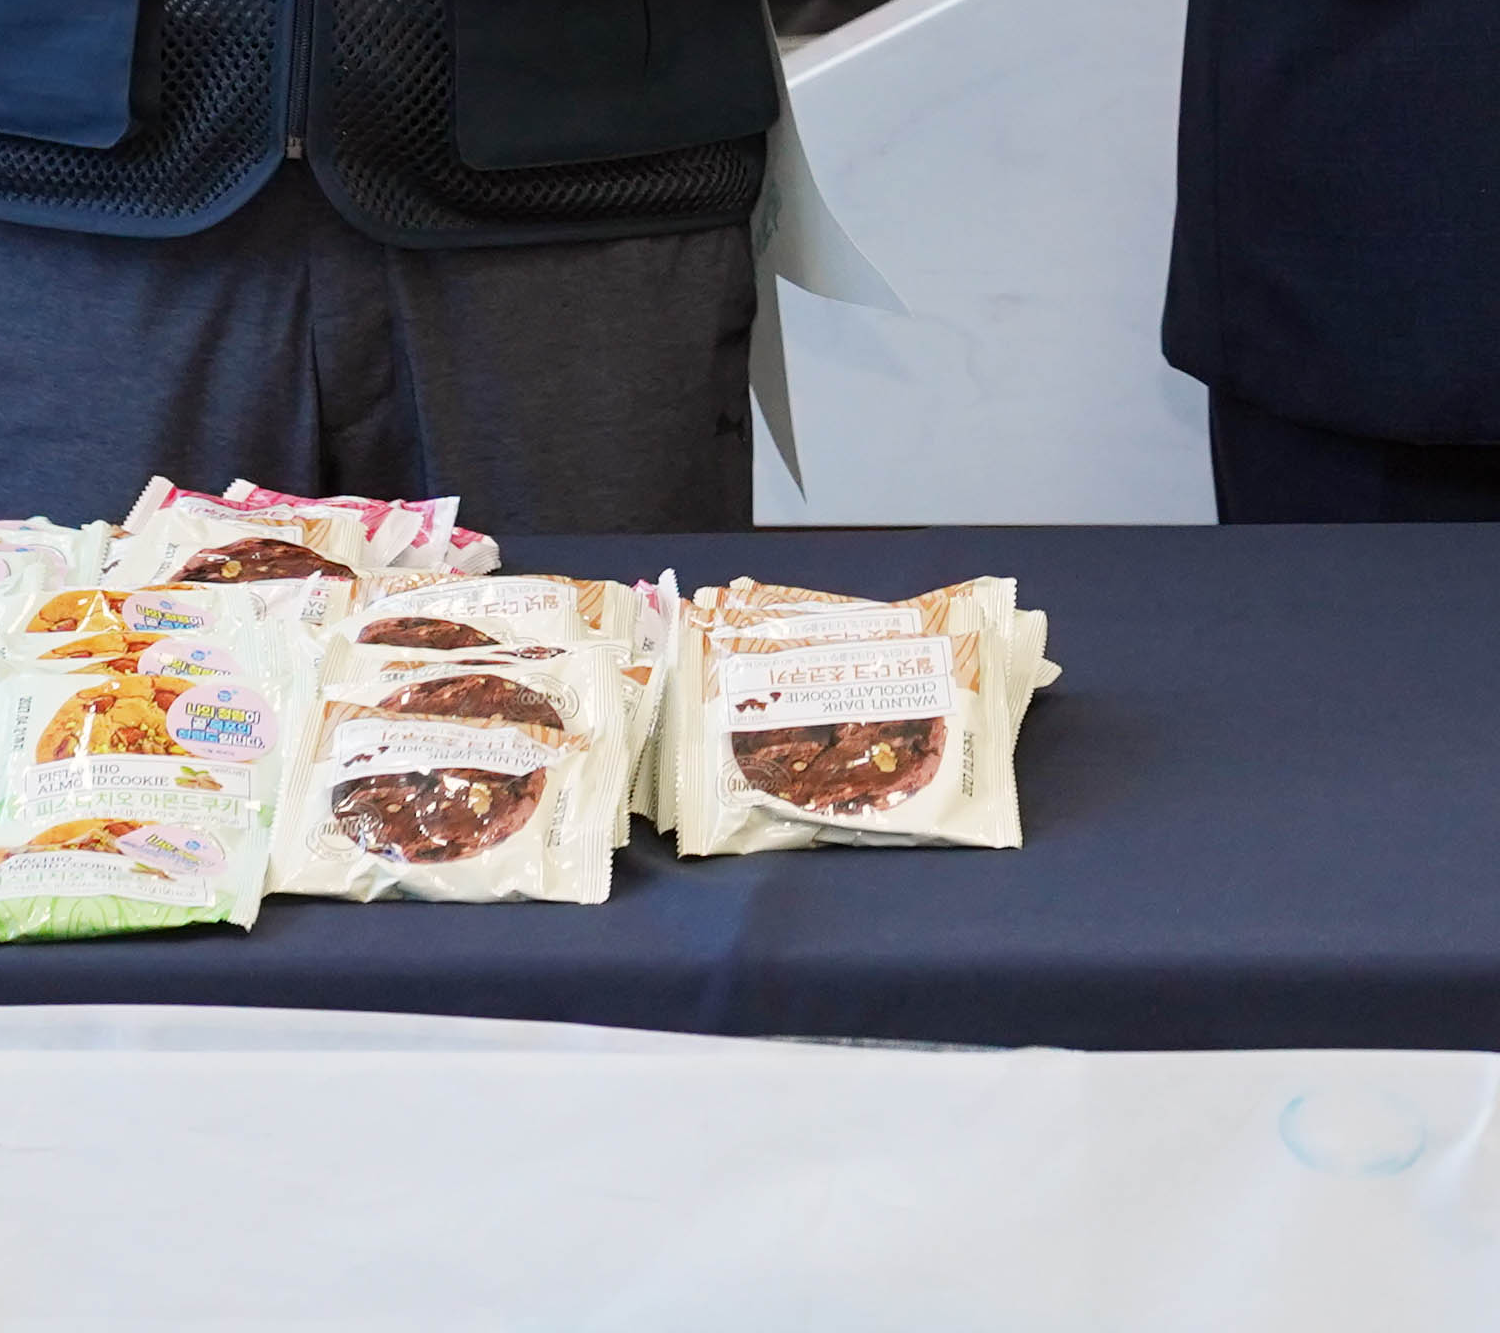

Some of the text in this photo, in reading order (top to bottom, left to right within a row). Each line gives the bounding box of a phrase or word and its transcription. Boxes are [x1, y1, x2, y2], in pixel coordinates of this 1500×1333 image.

[897, 657, 936, 674] 월넛
[770, 664, 846, 686] 초코쿠키
[783, 683, 937, 703] CHOCOLATE COOKIE
[823, 697, 938, 713] WALNUT DARK
[110, 775, 169, 787] COOKIE
[141, 791, 240, 816] 아몬드쿠키
